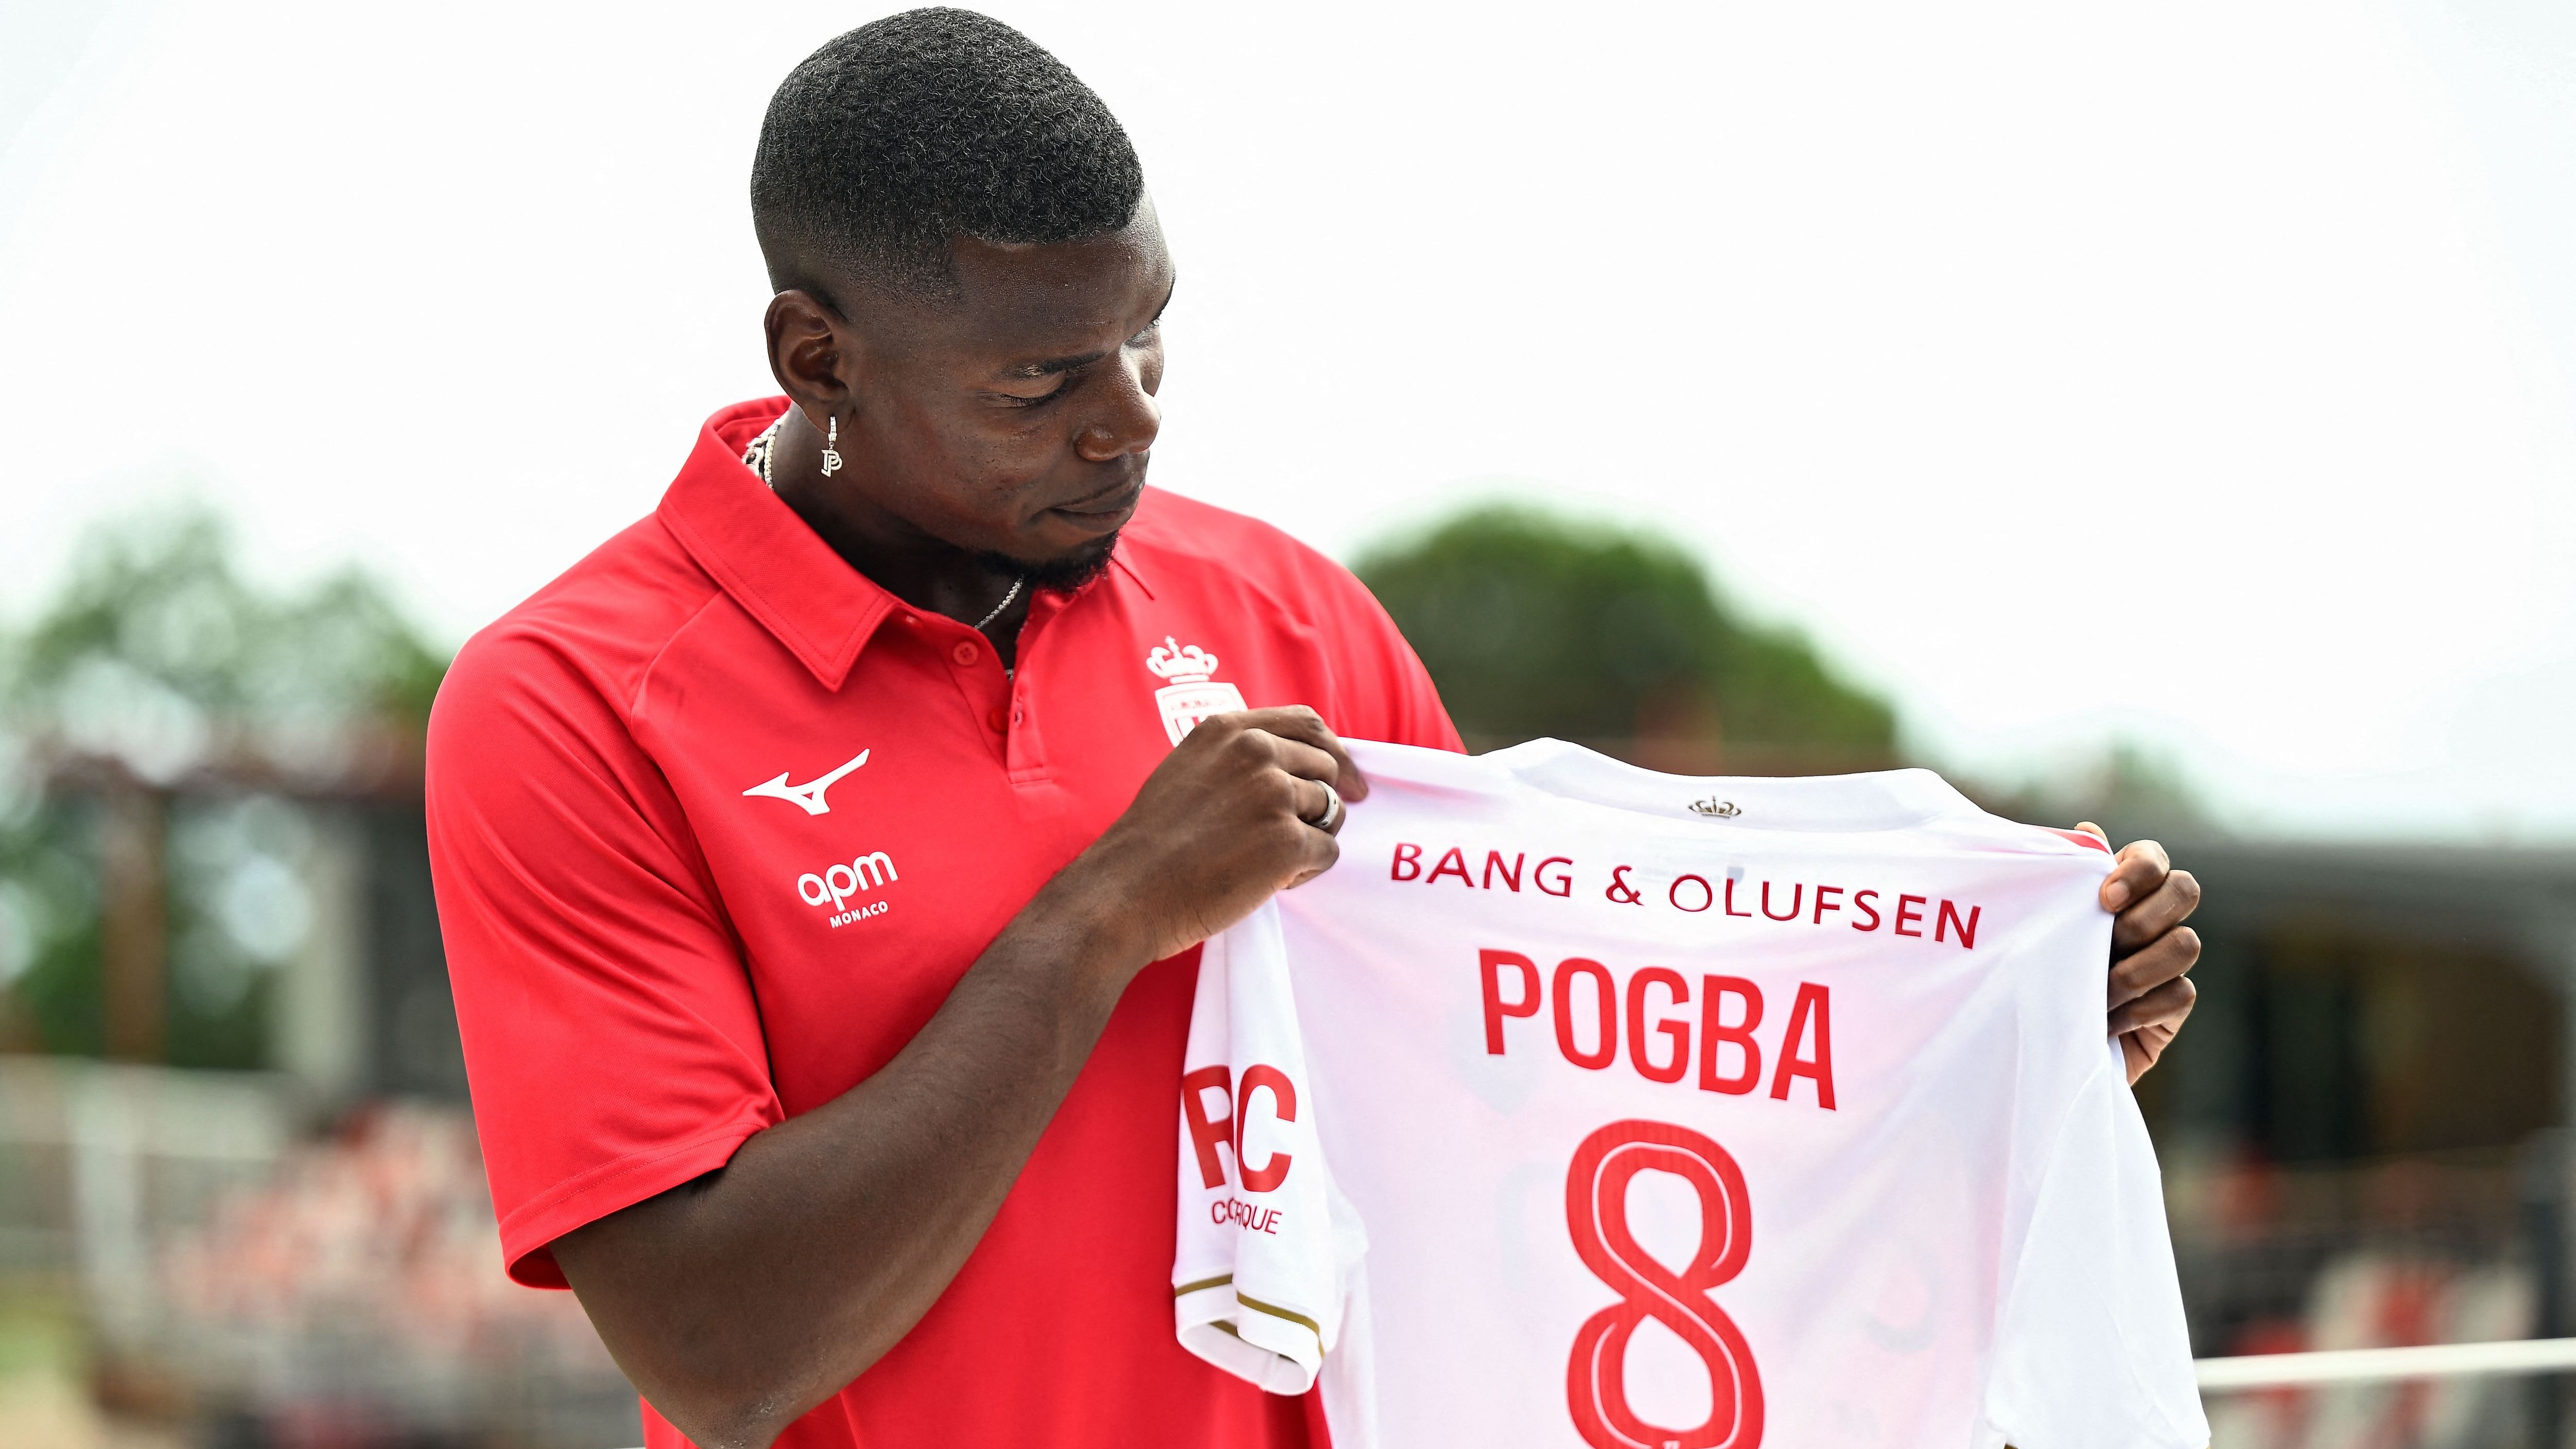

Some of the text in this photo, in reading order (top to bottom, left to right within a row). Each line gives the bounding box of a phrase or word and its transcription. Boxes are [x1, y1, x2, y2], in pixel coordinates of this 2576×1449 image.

[797, 851, 899, 912] apm
[829, 900, 889, 929] MONACO
[1390, 843, 1982, 950] BANG & OLUFSEN
[1478, 948, 1837, 1112] POGBA
[1564, 1118, 1766, 1449] 8
